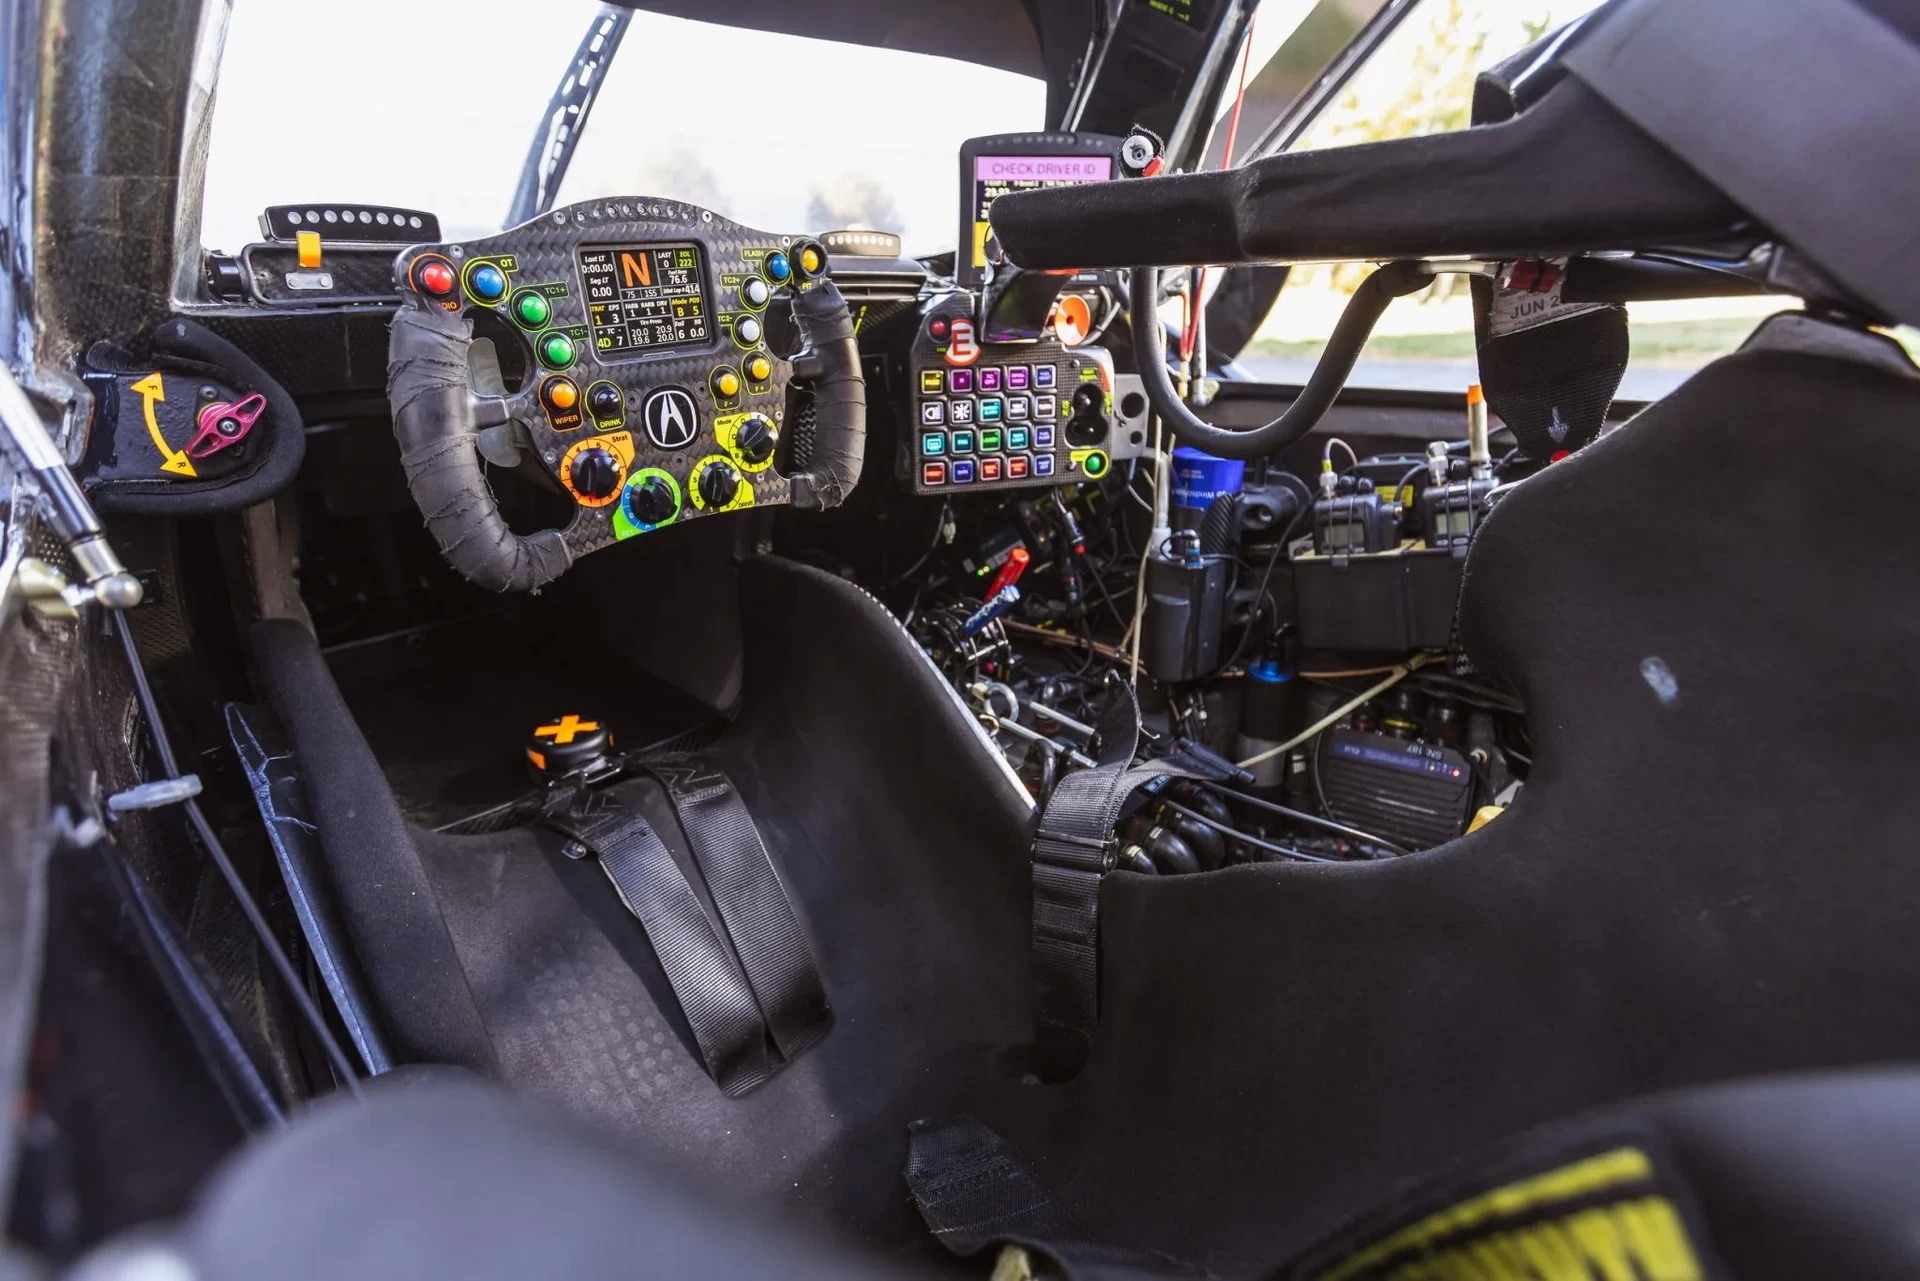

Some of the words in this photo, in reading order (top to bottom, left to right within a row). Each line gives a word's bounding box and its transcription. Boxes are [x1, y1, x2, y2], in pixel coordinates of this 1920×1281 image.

[992, 163, 1032, 174] CHECK
[1037, 163, 1081, 174] DRIVER
[1084, 164, 1096, 174] ID
[501, 259, 513, 267] OT
[663, 260, 669, 268] 0
[679, 259, 692, 267] 222
[582, 263, 613, 274] 0:00.00
[621, 252, 651, 287] N
[669, 275, 688, 284] 76.6
[545, 287, 566, 295] TC1+
[592, 287, 612, 297] 0.00
[685, 285, 700, 293] 414
[626, 291, 635, 299] 75
[677, 308, 684, 317] B
[693, 306, 699, 315] 5
[1511, 299, 1544, 319] JUN
[595, 315, 602, 325] 1
[612, 314, 619, 323] 3
[569, 329, 587, 337] TC1-
[631, 328, 649, 338] 20.0
[656, 325, 672, 334] 20.9
[678, 330, 685, 339] 6
[690, 328, 704, 337] 0.0
[617, 337, 623, 346] 7
[633, 336, 650, 345] 19.6
[657, 333, 674, 342] 20.0
[952, 329, 971, 356] E
[554, 414, 578, 425] WIPER
[600, 419, 621, 428] DRINK
[612, 435, 628, 443] Strat
